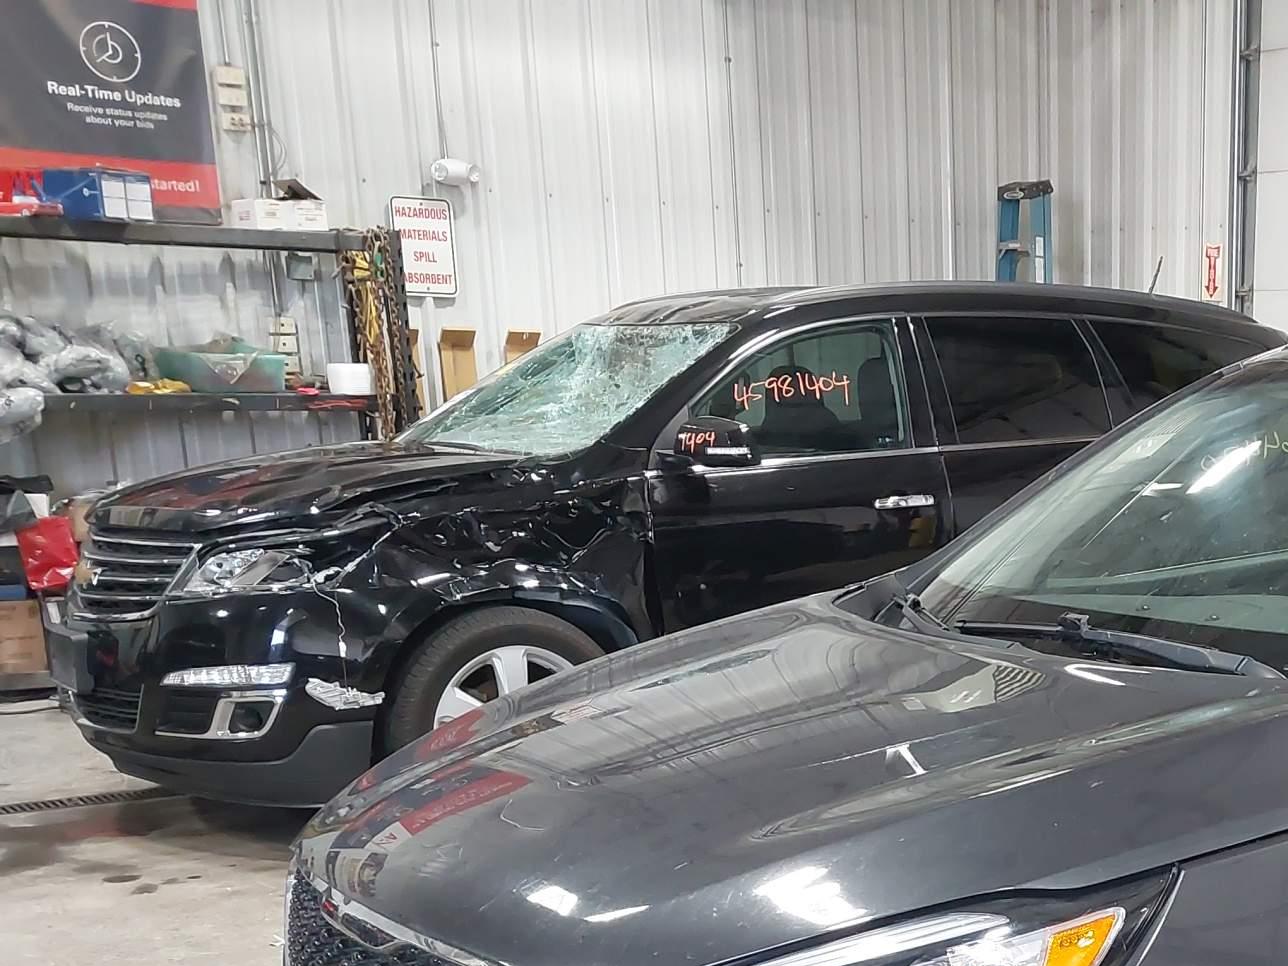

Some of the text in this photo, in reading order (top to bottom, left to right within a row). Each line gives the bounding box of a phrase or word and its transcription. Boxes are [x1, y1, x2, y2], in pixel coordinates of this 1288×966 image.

[47, 81, 181, 107] Real-Time Updates
[67, 102, 103, 114] Receive
[105, 107, 133, 117] status
[85, 115, 112, 126] about
[114, 118, 134, 127] your
[394, 206, 448, 220] HAZARDOUS
[400, 228, 448, 242] MATERIALS
[413, 250, 438, 263] SPILL
[733, 371, 850, 411] 45981404
